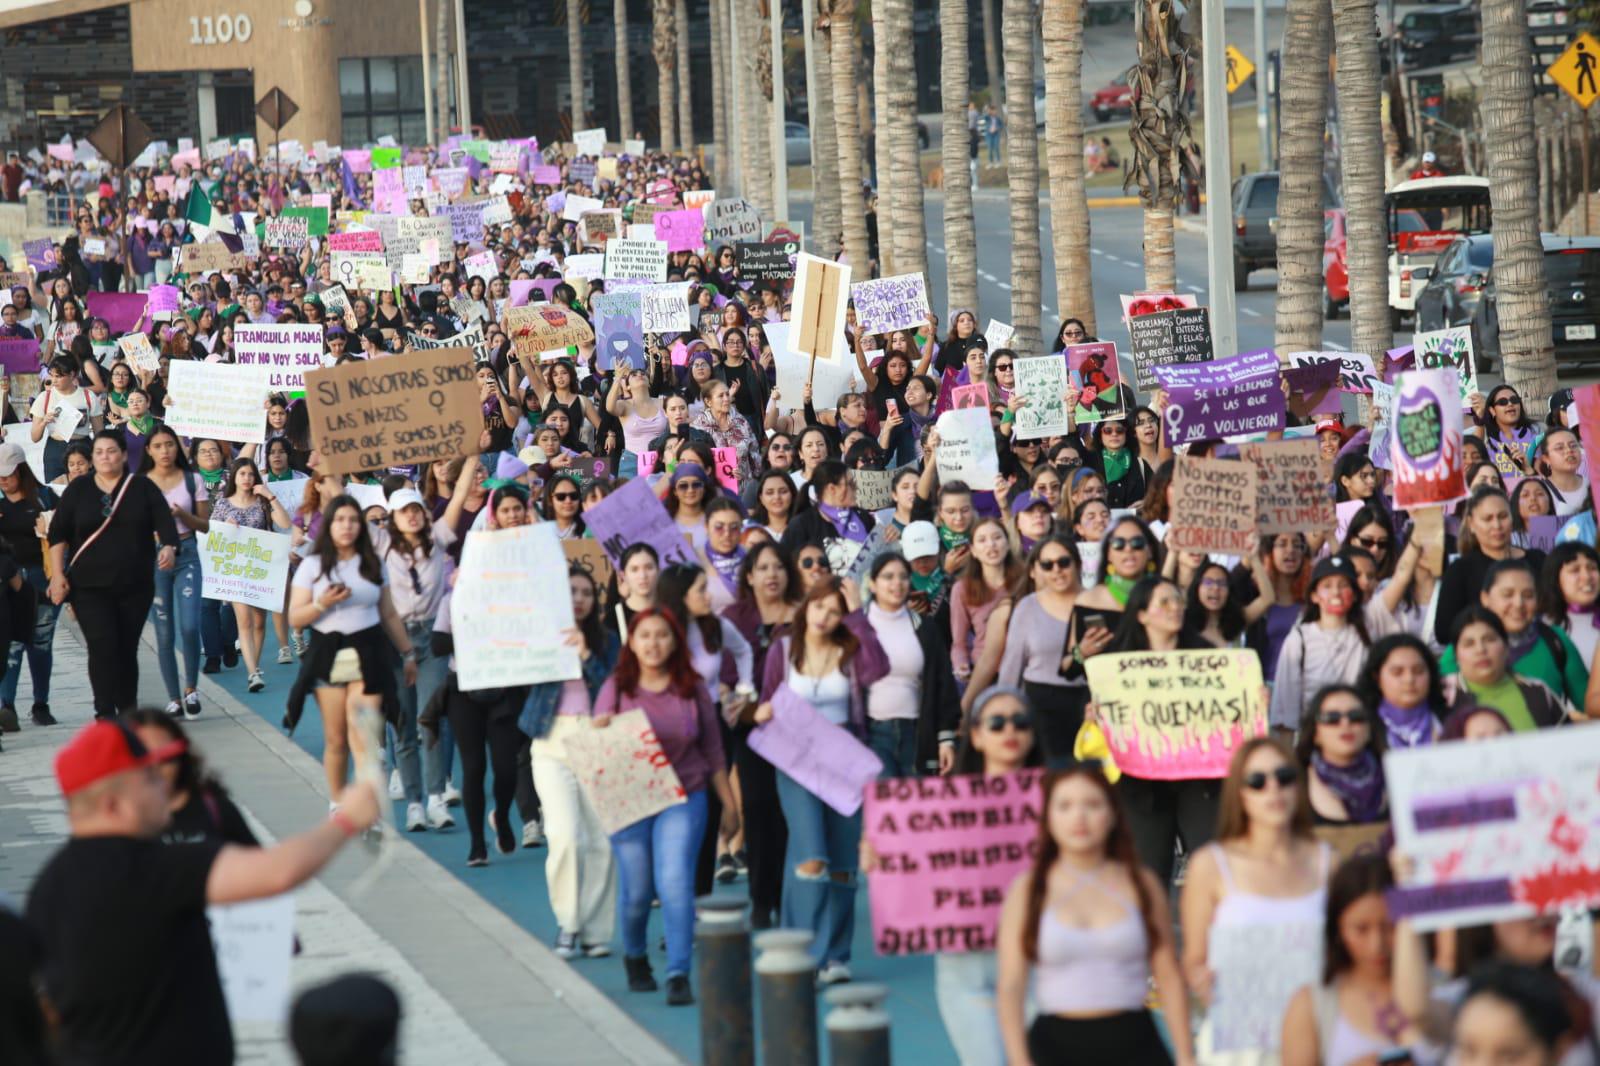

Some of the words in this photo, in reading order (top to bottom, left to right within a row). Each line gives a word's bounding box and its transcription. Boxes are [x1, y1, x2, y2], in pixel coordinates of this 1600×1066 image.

[188, 15, 252, 45] 1100
[235, 330, 290, 344] TRANQUILA
[238, 351, 256, 365] HOY
[258, 352, 270, 365] NO
[273, 352, 291, 366] VOY
[295, 352, 320, 365] SOLA
[1134, 352, 1146, 361] NO
[270, 373, 282, 386] LA
[317, 380, 340, 407] SI
[347, 367, 429, 400] NOSOTRAS
[432, 361, 475, 387] SOMOS
[1194, 388, 1209, 400] SE
[1215, 387, 1229, 397] LO
[1234, 378, 1274, 394] DEBEMOS
[1201, 402, 1210, 415] A
[1223, 399, 1239, 411] LAS
[1247, 394, 1267, 406] QUE
[326, 409, 358, 432] LAS
[1186, 423, 1206, 438] NO
[1213, 411, 1279, 434] VOLVIERON
[321, 437, 358, 457] ¿POR
[394, 424, 437, 445] SOMOS
[439, 420, 467, 438] LAS
[359, 452, 384, 469] QUE
[393, 437, 465, 462] MORIMOS?
[1178, 460, 1201, 479] No
[1203, 470, 1248, 487] vamos
[1183, 483, 1243, 501] contra
[1177, 498, 1250, 517] corriente
[1119, 655, 1168, 672] SOMOS
[1178, 655, 1229, 672] FUEGO
[1179, 675, 1226, 690] TOCAS
